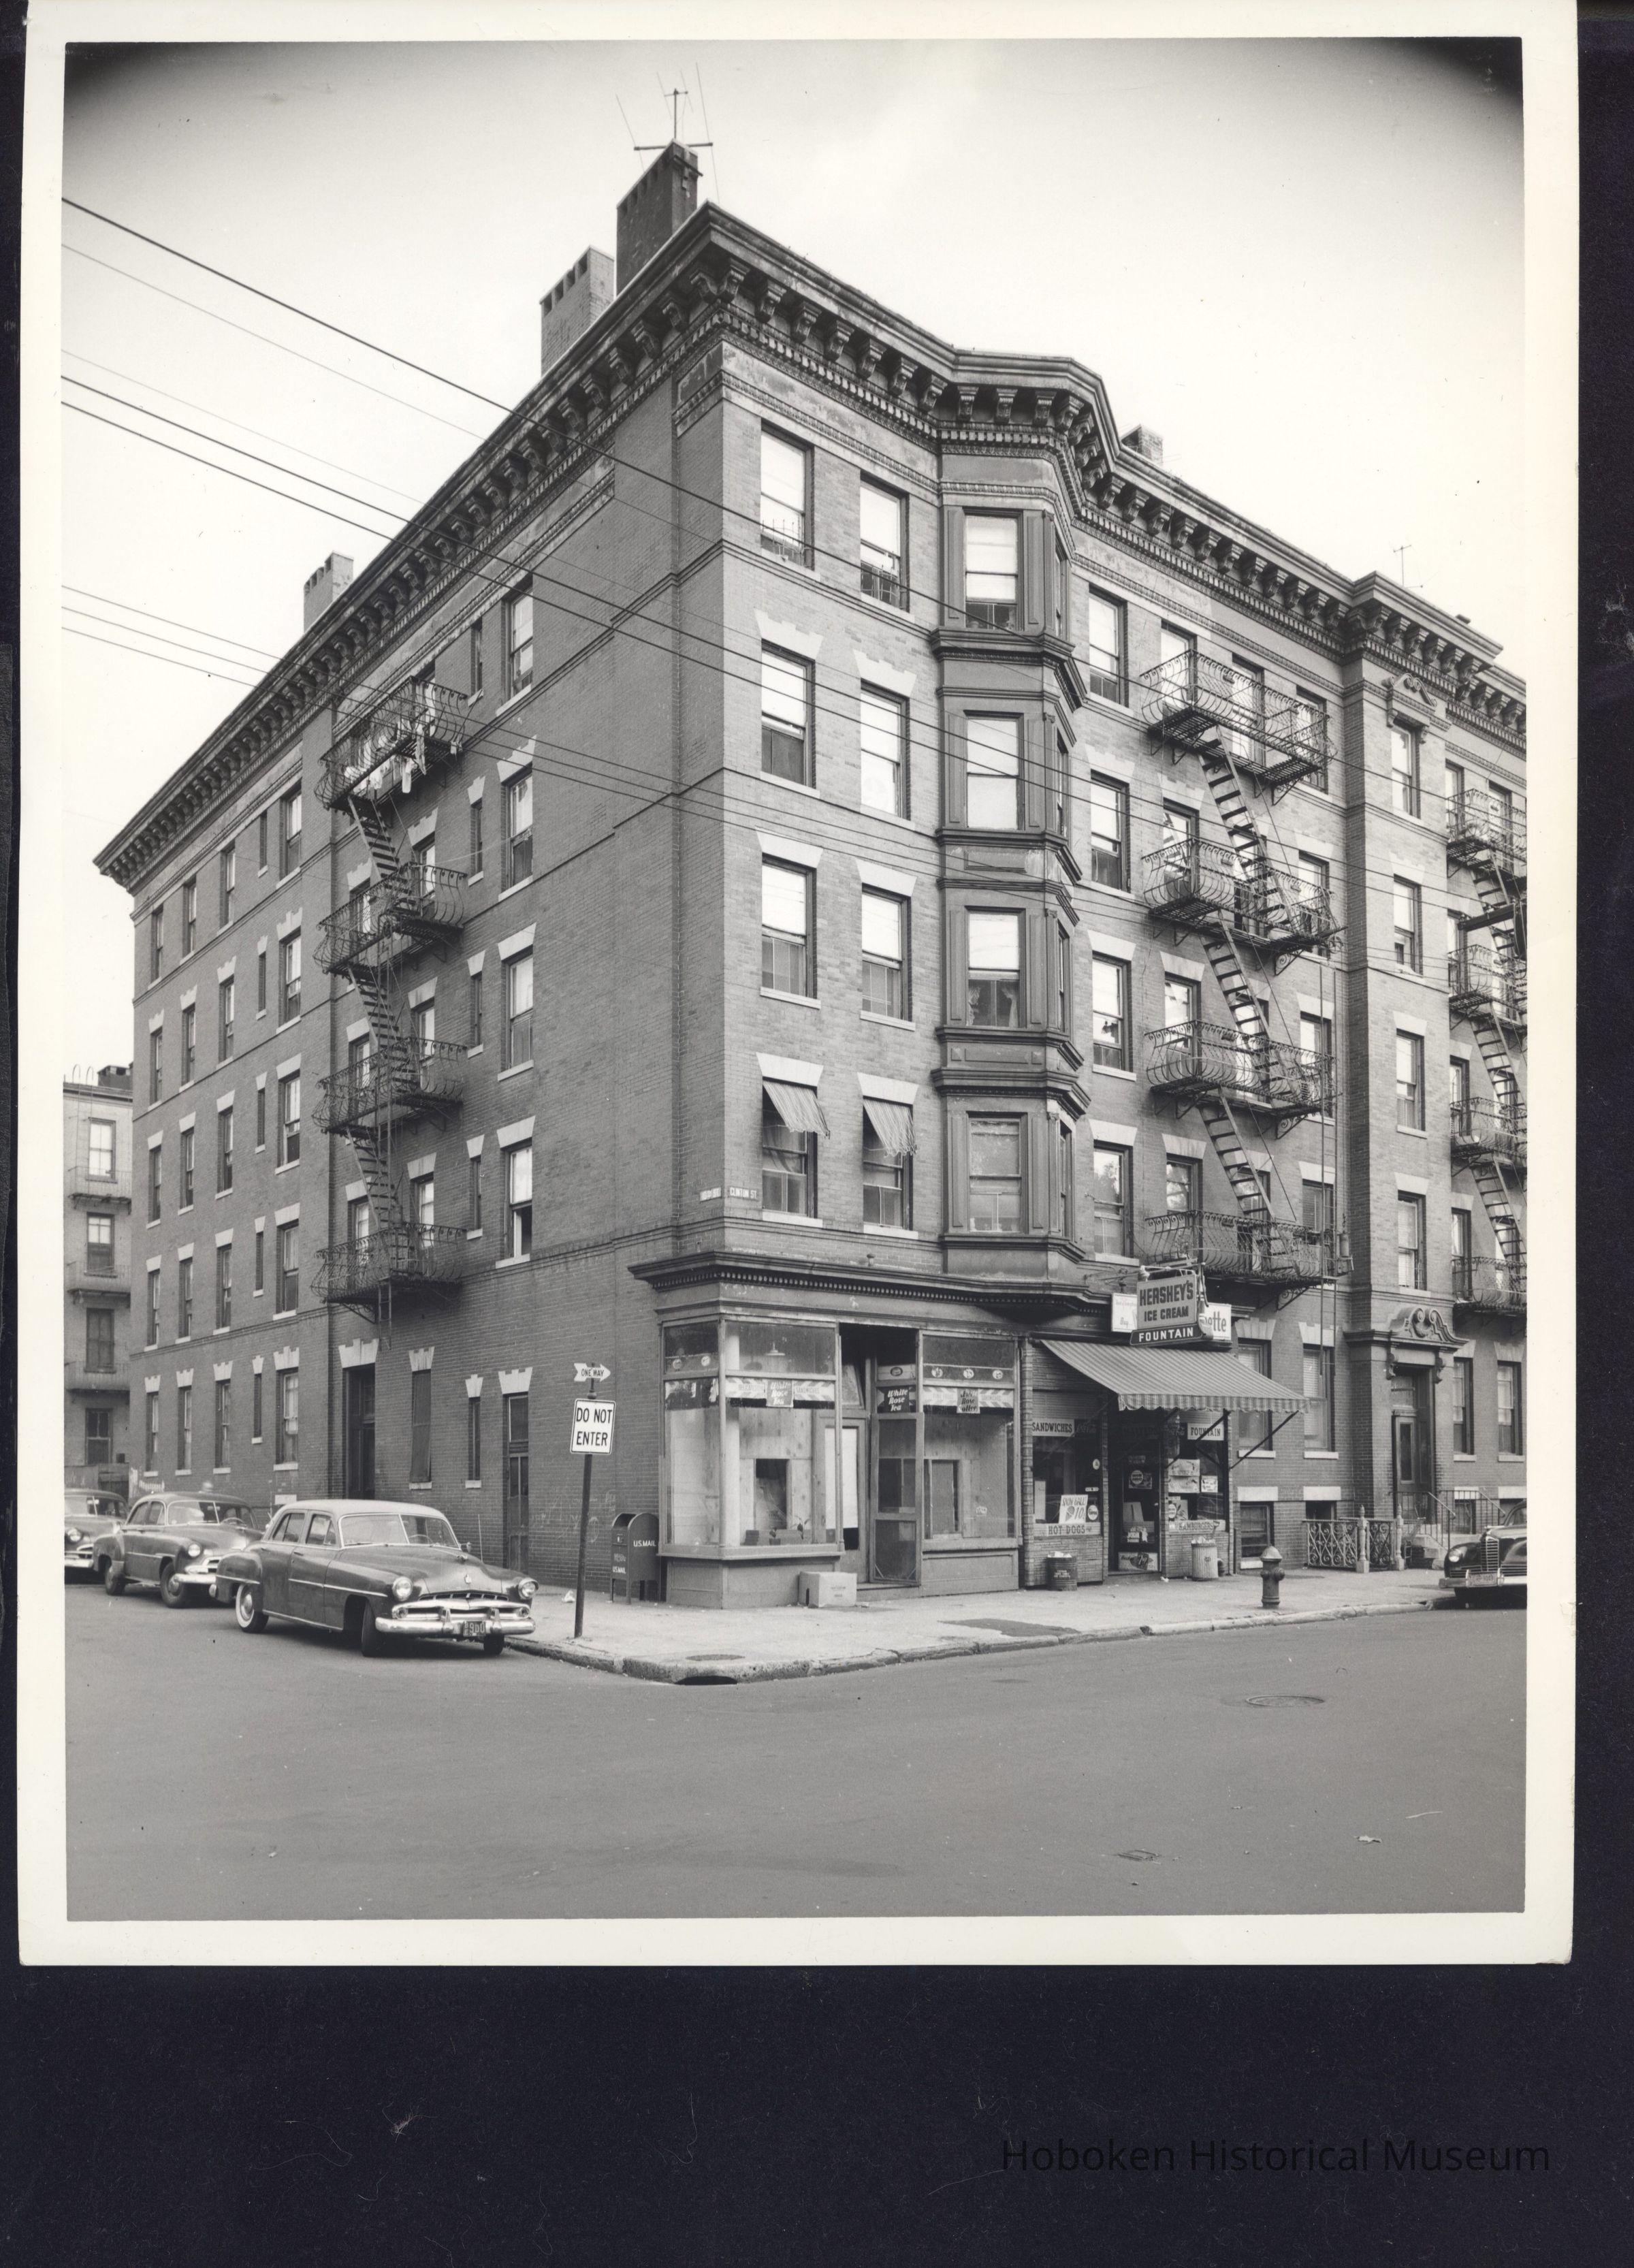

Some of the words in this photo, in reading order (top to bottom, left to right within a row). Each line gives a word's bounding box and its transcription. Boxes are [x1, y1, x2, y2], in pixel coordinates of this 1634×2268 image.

[730, 1187, 749, 1198] CLINTON
[750, 1189, 756, 1199] ST
[1139, 1280, 1194, 1307] HERSHEY'S
[1144, 1310, 1157, 1322] ICE
[1160, 1306, 1189, 1320] CREAM
[1205, 1311, 1226, 1332] ette
[1138, 1327, 1194, 1343] FOUNTAIN
[581, 1369, 591, 1377] ONE
[887, 1388, 909, 1398] White
[888, 1396, 906, 1405] Rose
[576, 1407, 590, 1422] DO
[594, 1408, 613, 1424] NOT
[1031, 1422, 1073, 1433] SANDWICHES
[1190, 1426, 1221, 1437] FOUNAIN
[576, 1431, 608, 1446] ENTER
[1048, 1525, 1063, 1535] HOT
[1066, 1524, 1086, 1535] DOGS
[1179, 1521, 1215, 1531] HAMBURGERS
